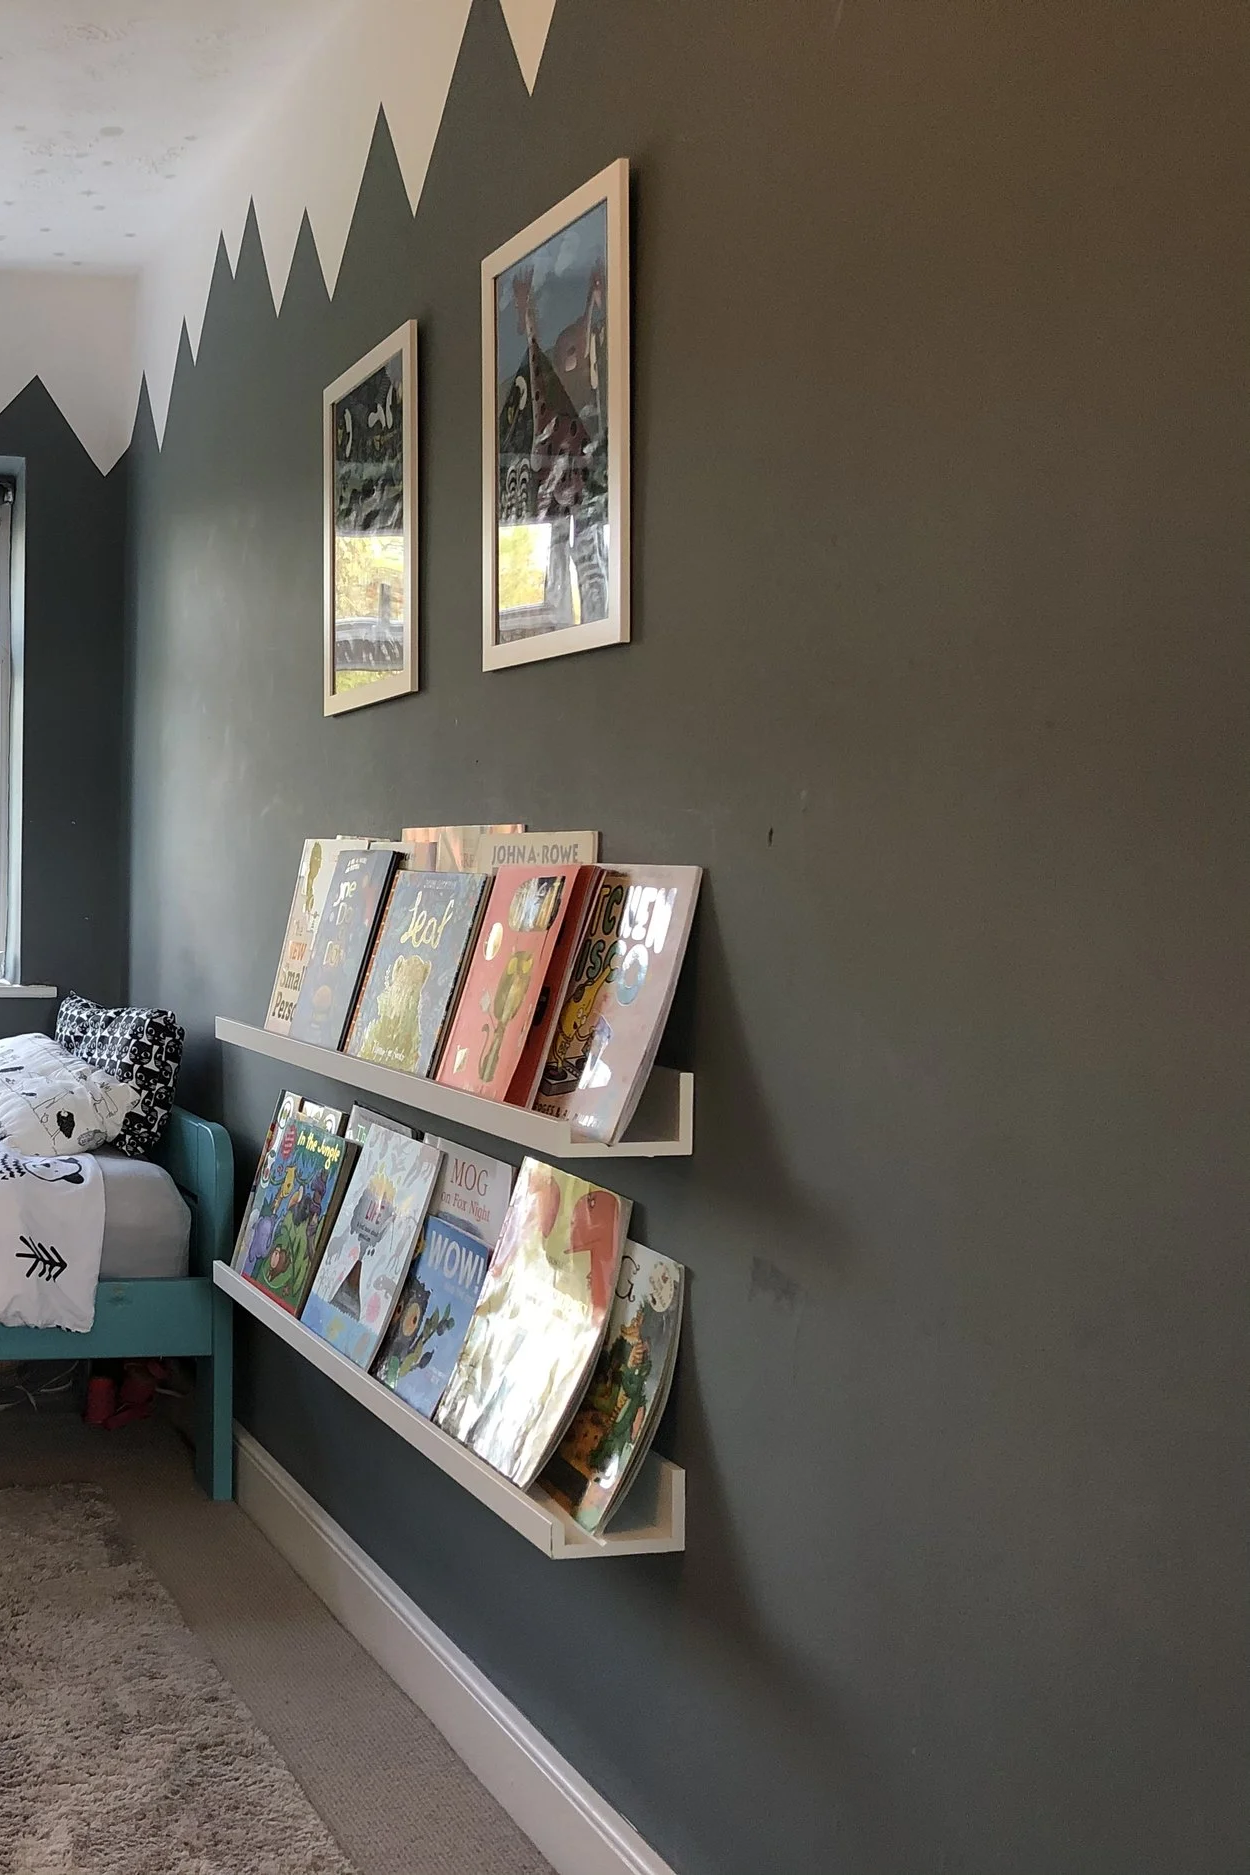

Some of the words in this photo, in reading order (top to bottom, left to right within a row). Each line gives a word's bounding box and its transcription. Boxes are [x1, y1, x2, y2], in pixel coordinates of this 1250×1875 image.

[491, 844, 525, 865] JOHN
[297, 1131, 306, 1146] In
[305, 1132, 318, 1153] the
[317, 1139, 341, 1170] Jungle
[450, 1158, 489, 1197] MOG
[441, 1191, 451, 1204] on
[453, 1193, 467, 1212] Fox
[469, 1200, 491, 1222] Night
[428, 1230, 485, 1294] WOW!
